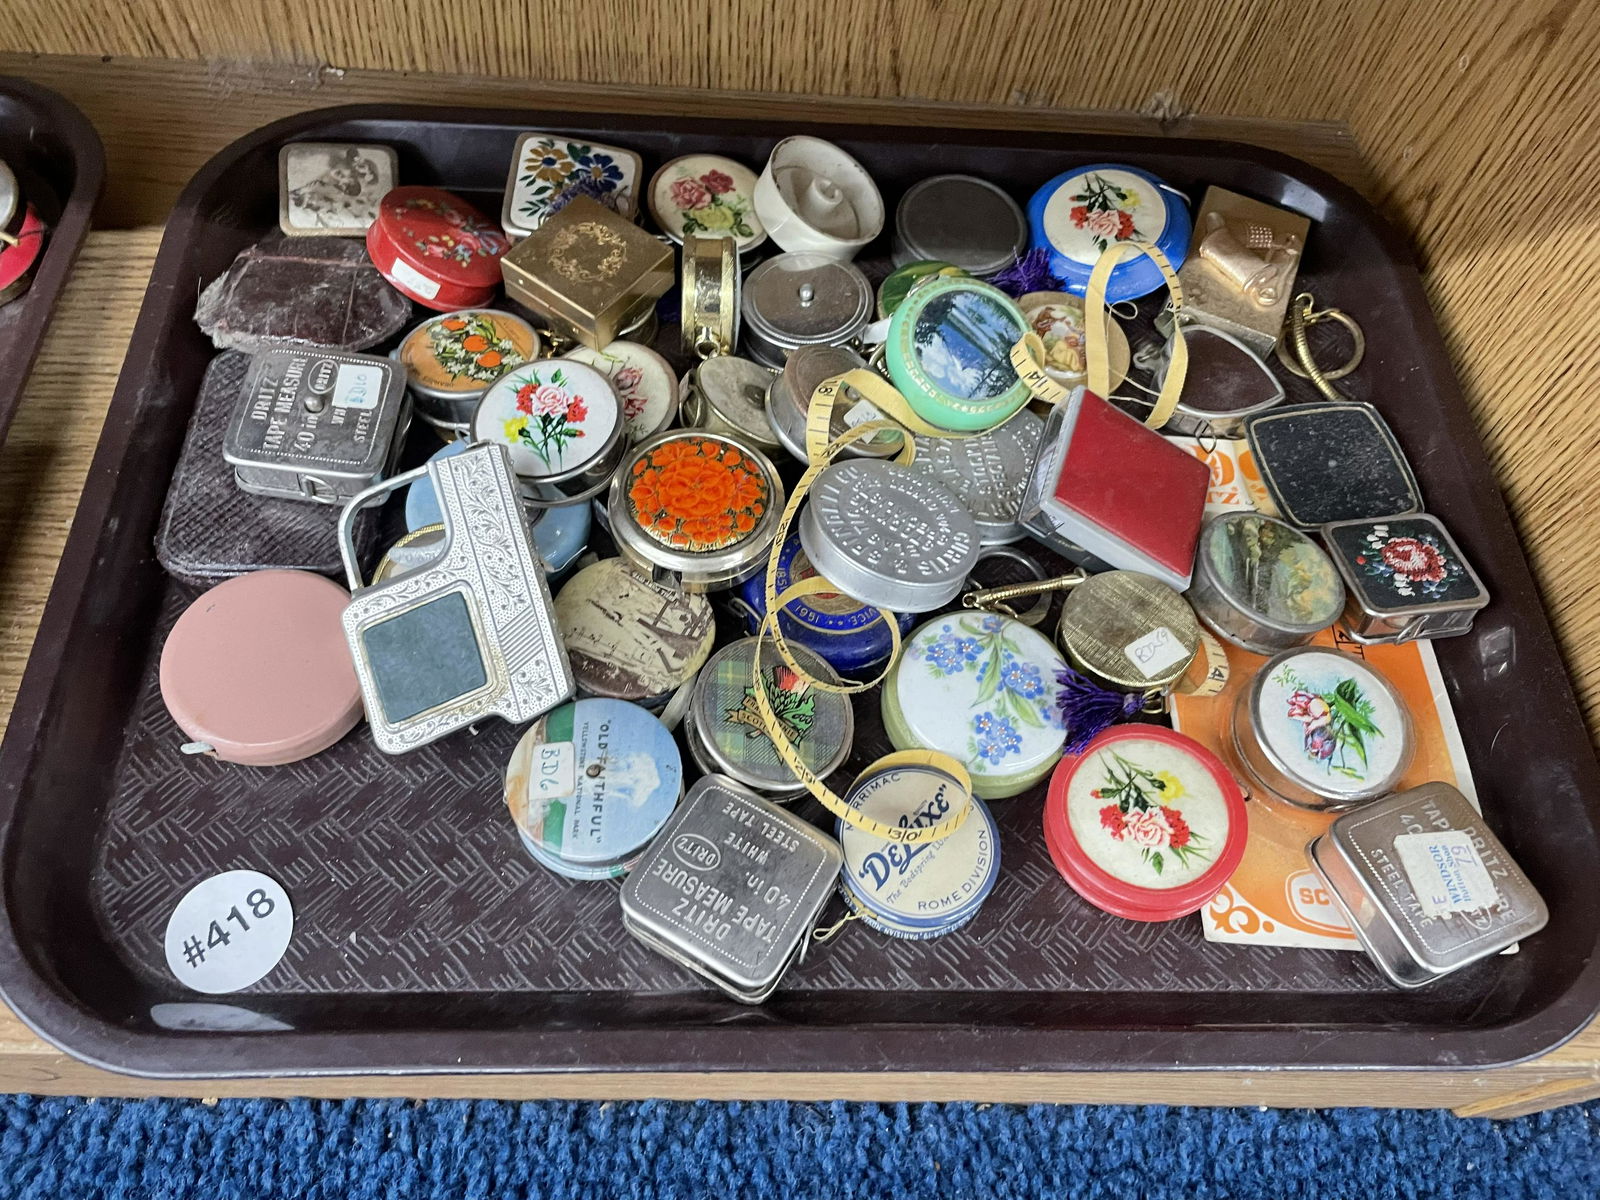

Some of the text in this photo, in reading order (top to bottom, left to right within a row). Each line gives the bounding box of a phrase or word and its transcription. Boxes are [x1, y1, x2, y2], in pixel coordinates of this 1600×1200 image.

[250, 376, 279, 421] DRITZ
[262, 415, 288, 450] TAPE
[294, 431, 316, 452] 40
[353, 410, 373, 443] STEEL
[918, 531, 972, 577] CURTIS
[571, 721, 590, 841] YELLOWSTONE NATIONAL PARK
[721, 800, 800, 852] STEEL TAPE
[1420, 800, 1456, 832] TAP
[677, 836, 719, 867] DRITZ
[723, 831, 769, 866] WHITE
[917, 890, 963, 911] ROME
[961, 829, 989, 894] DIVISION
[1370, 848, 1405, 889] STEEL
[1441, 844, 1456, 868] Shop
[1428, 844, 1461, 904] WINDSOR
[651, 858, 778, 944] TAPE MEASURE
[671, 897, 732, 942] DRITZ
[763, 885, 791, 912] 40
[182, 888, 276, 969] #418
